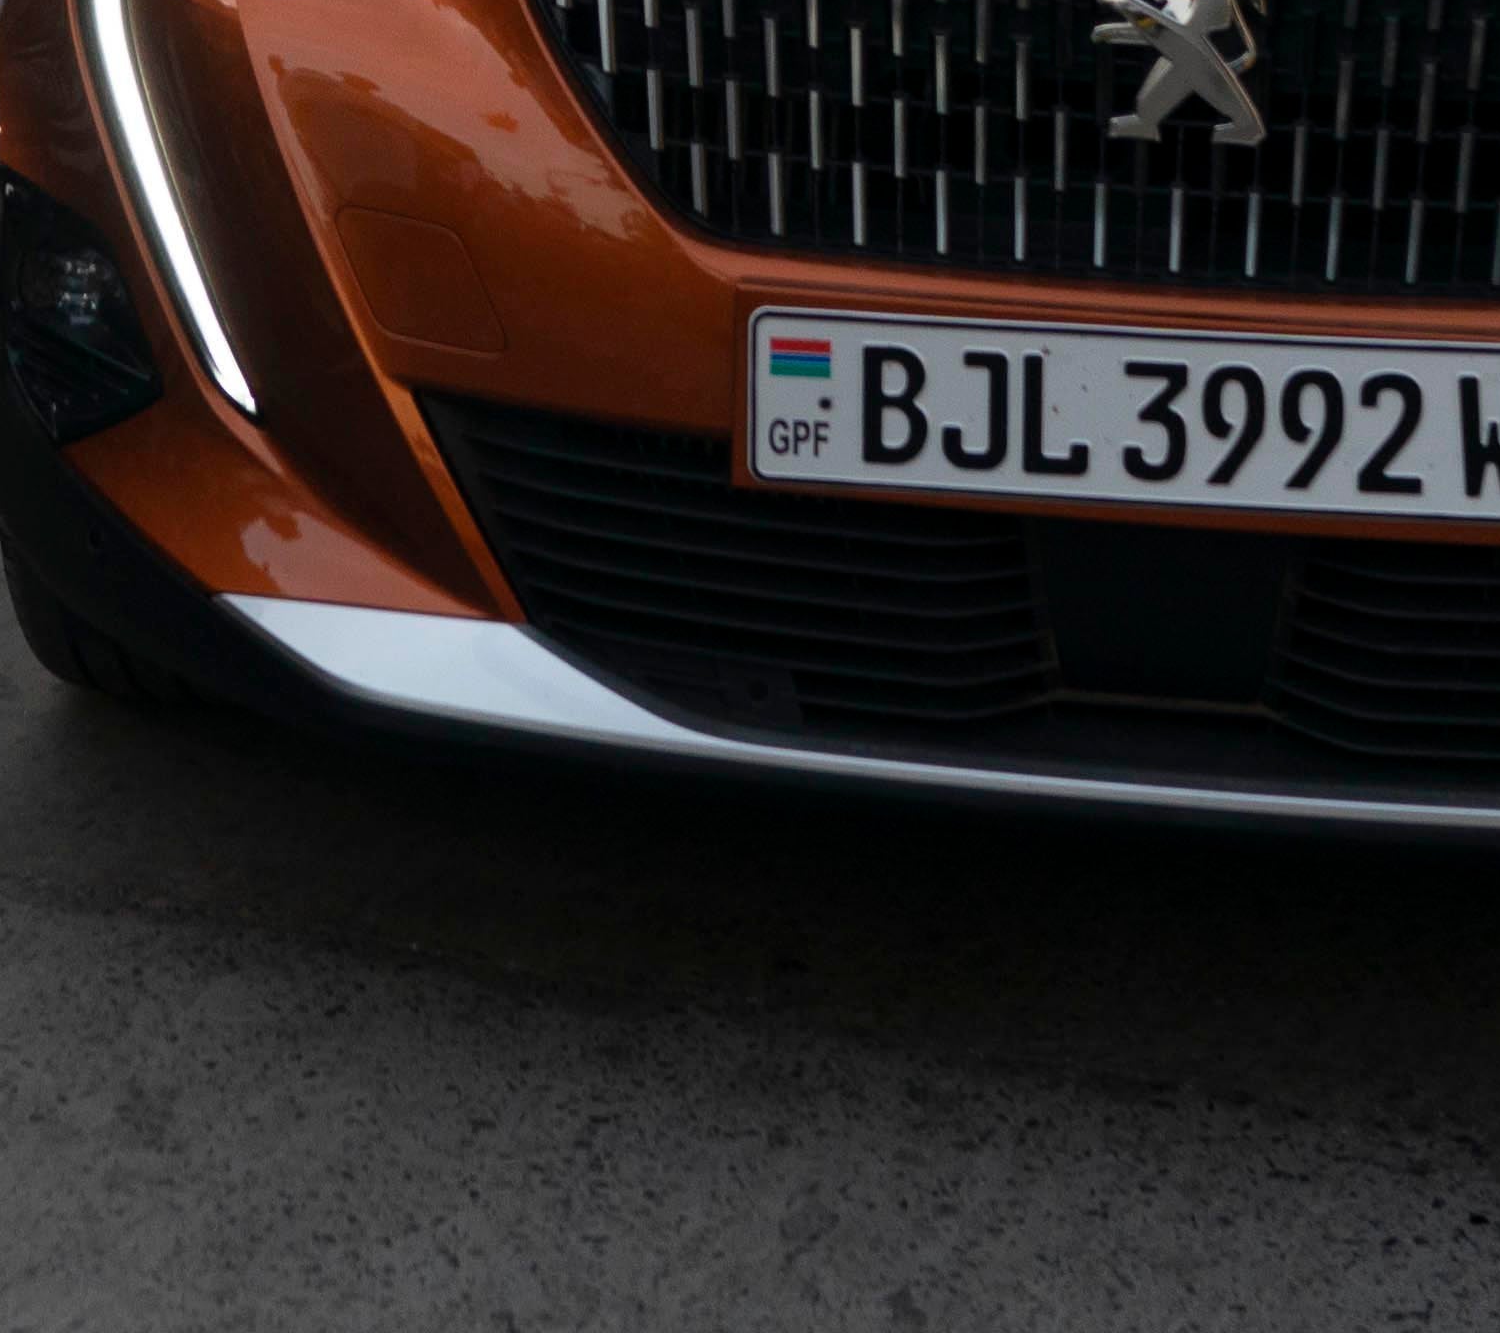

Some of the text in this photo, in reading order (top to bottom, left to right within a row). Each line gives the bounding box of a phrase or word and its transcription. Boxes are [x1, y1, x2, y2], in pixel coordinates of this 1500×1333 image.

[767, 417, 830, 458] GPF
[861, 342, 1090, 475] BJL
[1122, 359, 1424, 494] 3992
